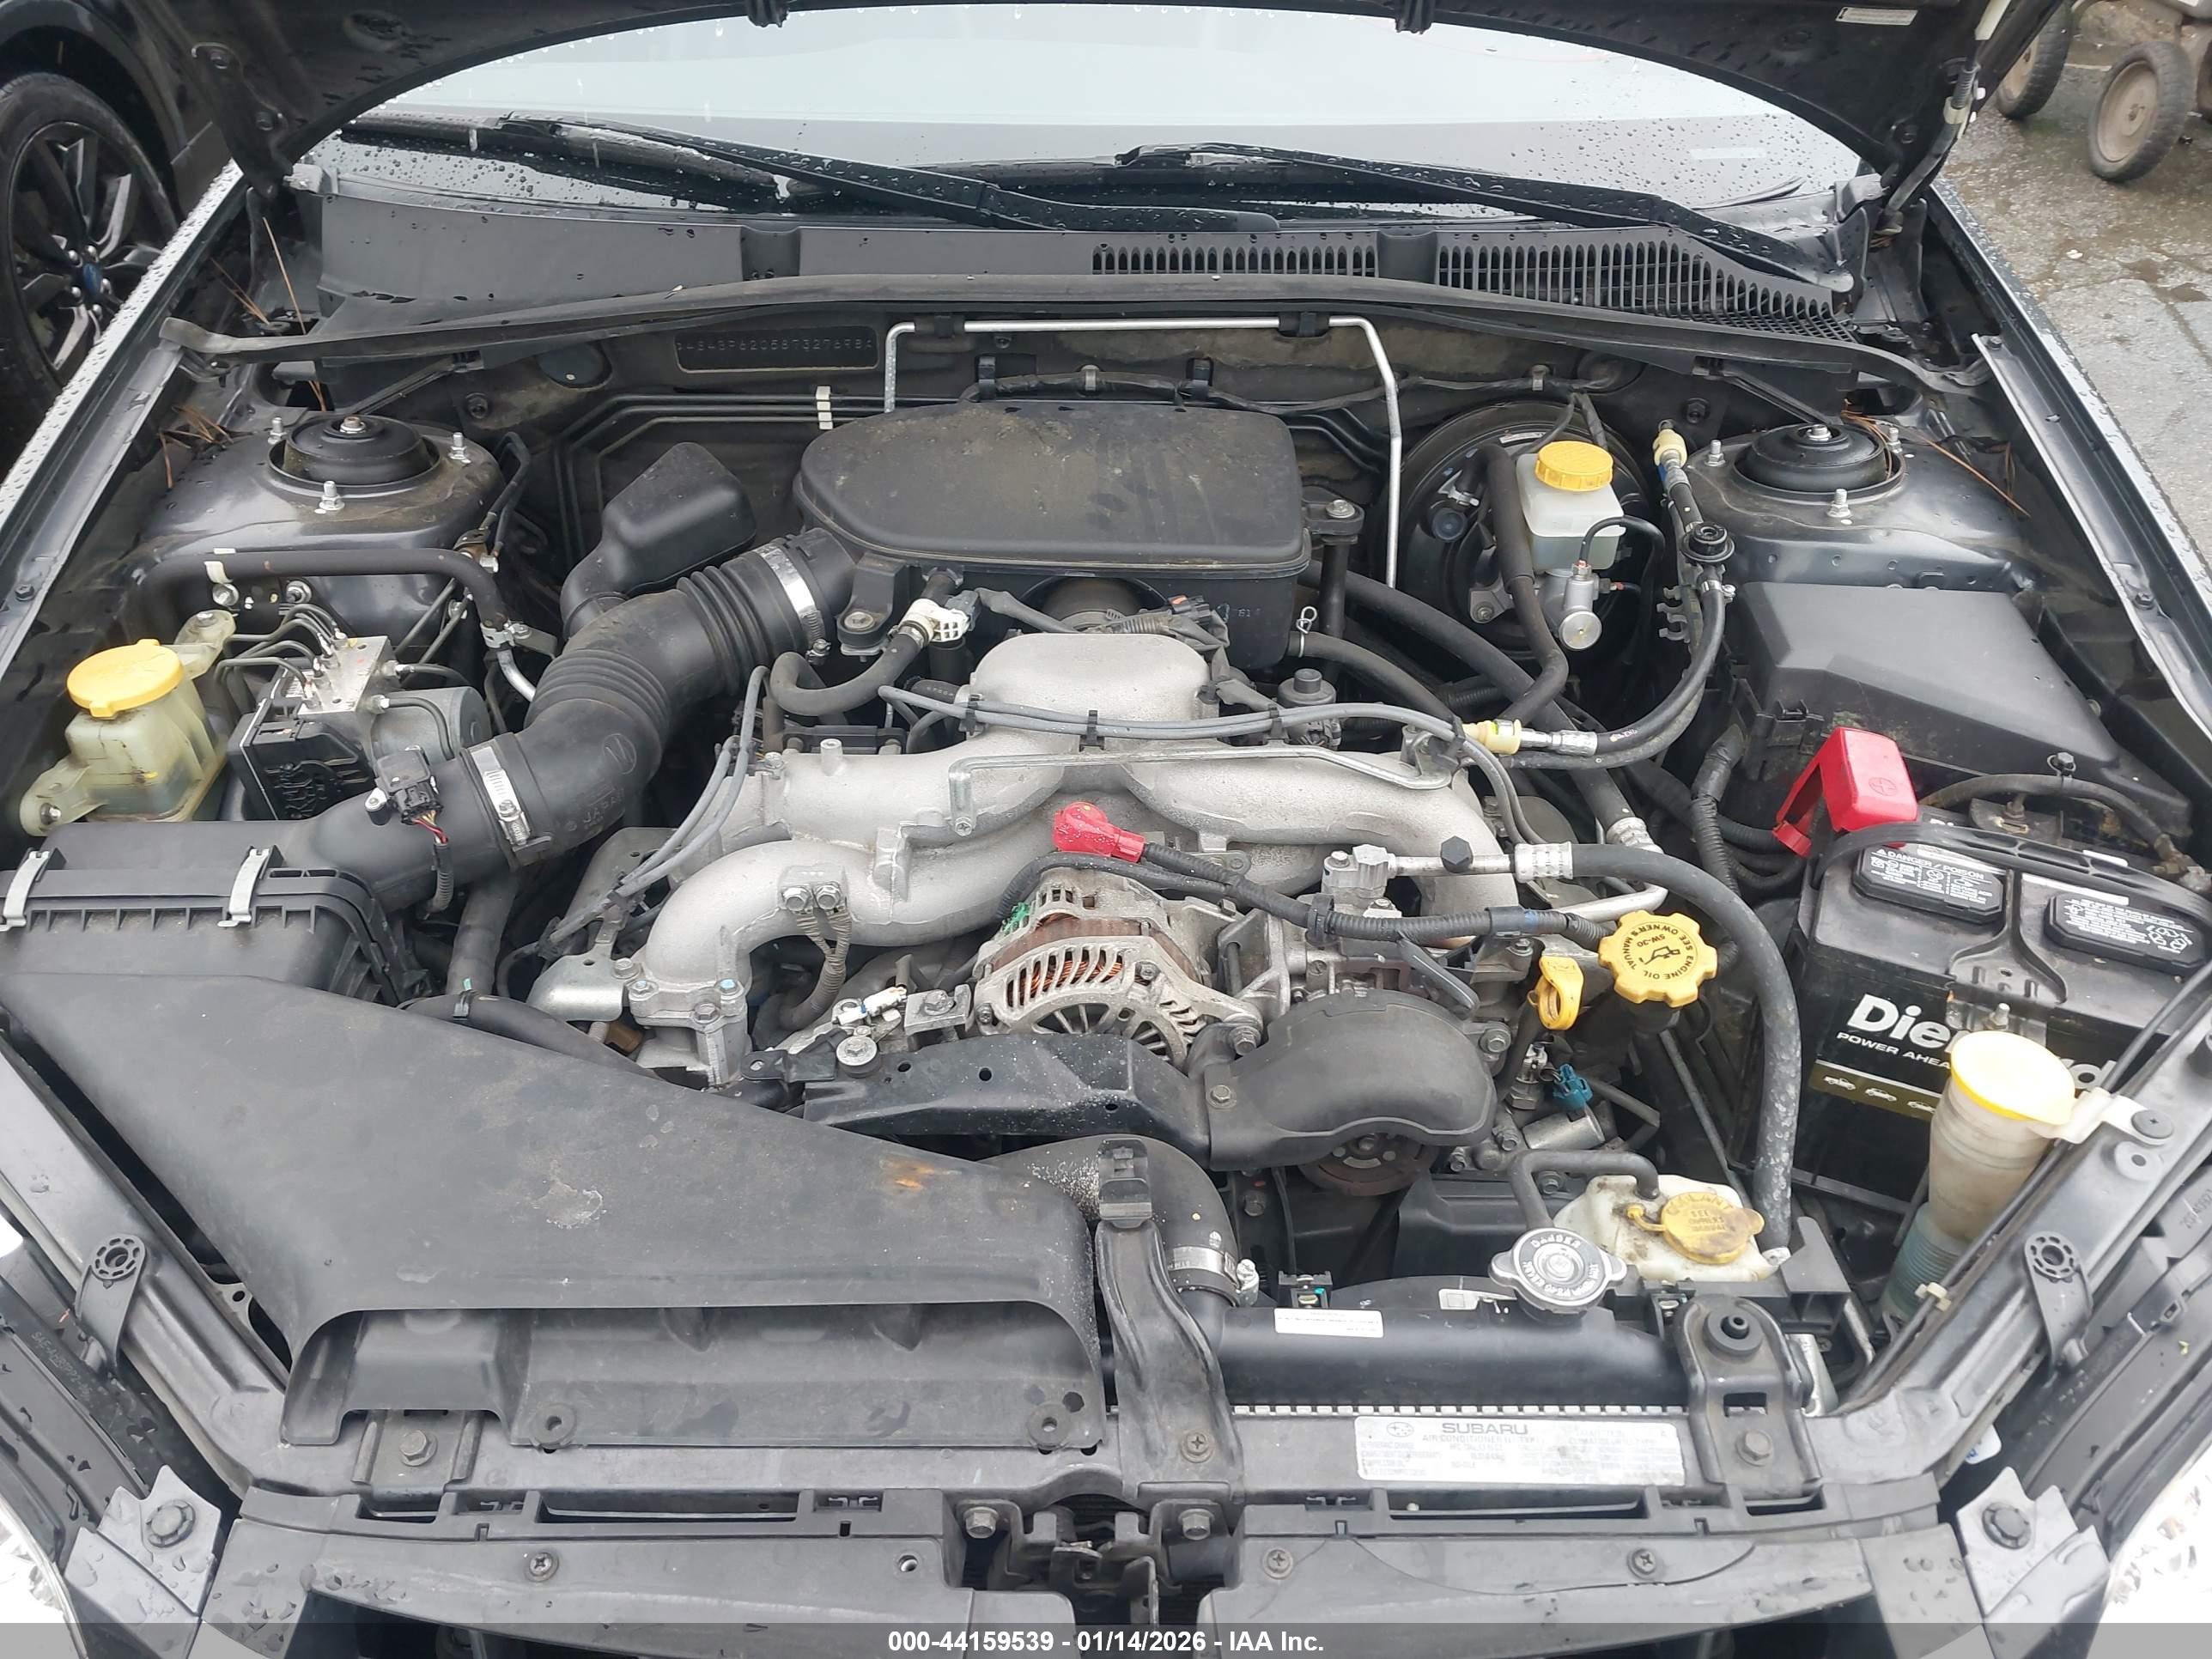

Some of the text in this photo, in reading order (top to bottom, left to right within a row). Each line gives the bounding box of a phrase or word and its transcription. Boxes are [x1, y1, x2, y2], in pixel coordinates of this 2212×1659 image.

[1887, 850, 1932, 868] DANGER
[1942, 863, 1984, 880] POISON
[1622, 936, 1638, 970] MANUAL
[1678, 933, 1694, 951] SEE
[1643, 955, 1694, 980] ENGINE OIL
[1836, 1031, 1951, 1070] POWER AHEA
[1442, 1422, 1528, 1435] SUBARU
